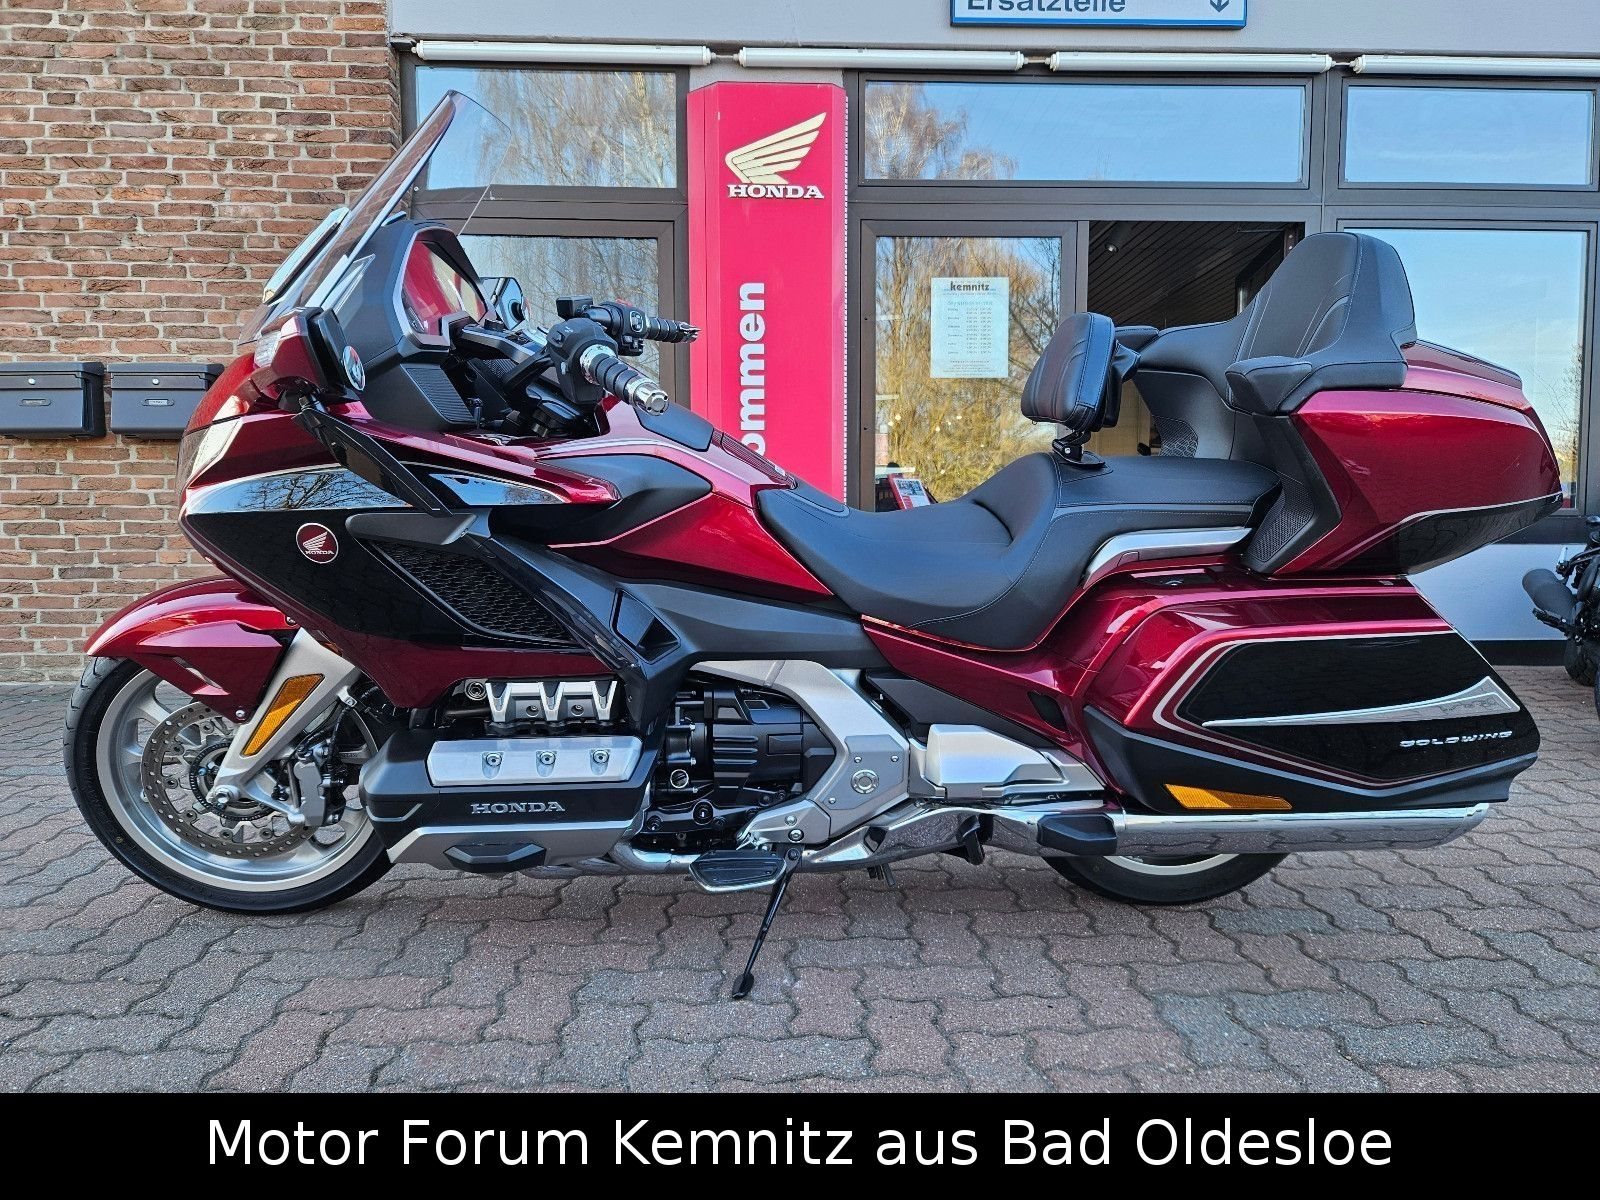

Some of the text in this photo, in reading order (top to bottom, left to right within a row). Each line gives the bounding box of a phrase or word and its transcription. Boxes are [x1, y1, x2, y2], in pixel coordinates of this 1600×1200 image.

[727, 184, 824, 199] HONDA
[950, 281, 990, 291] kemnitz
[1400, 730, 1513, 748] GOLDWING
[470, 801, 566, 815] HONDA
